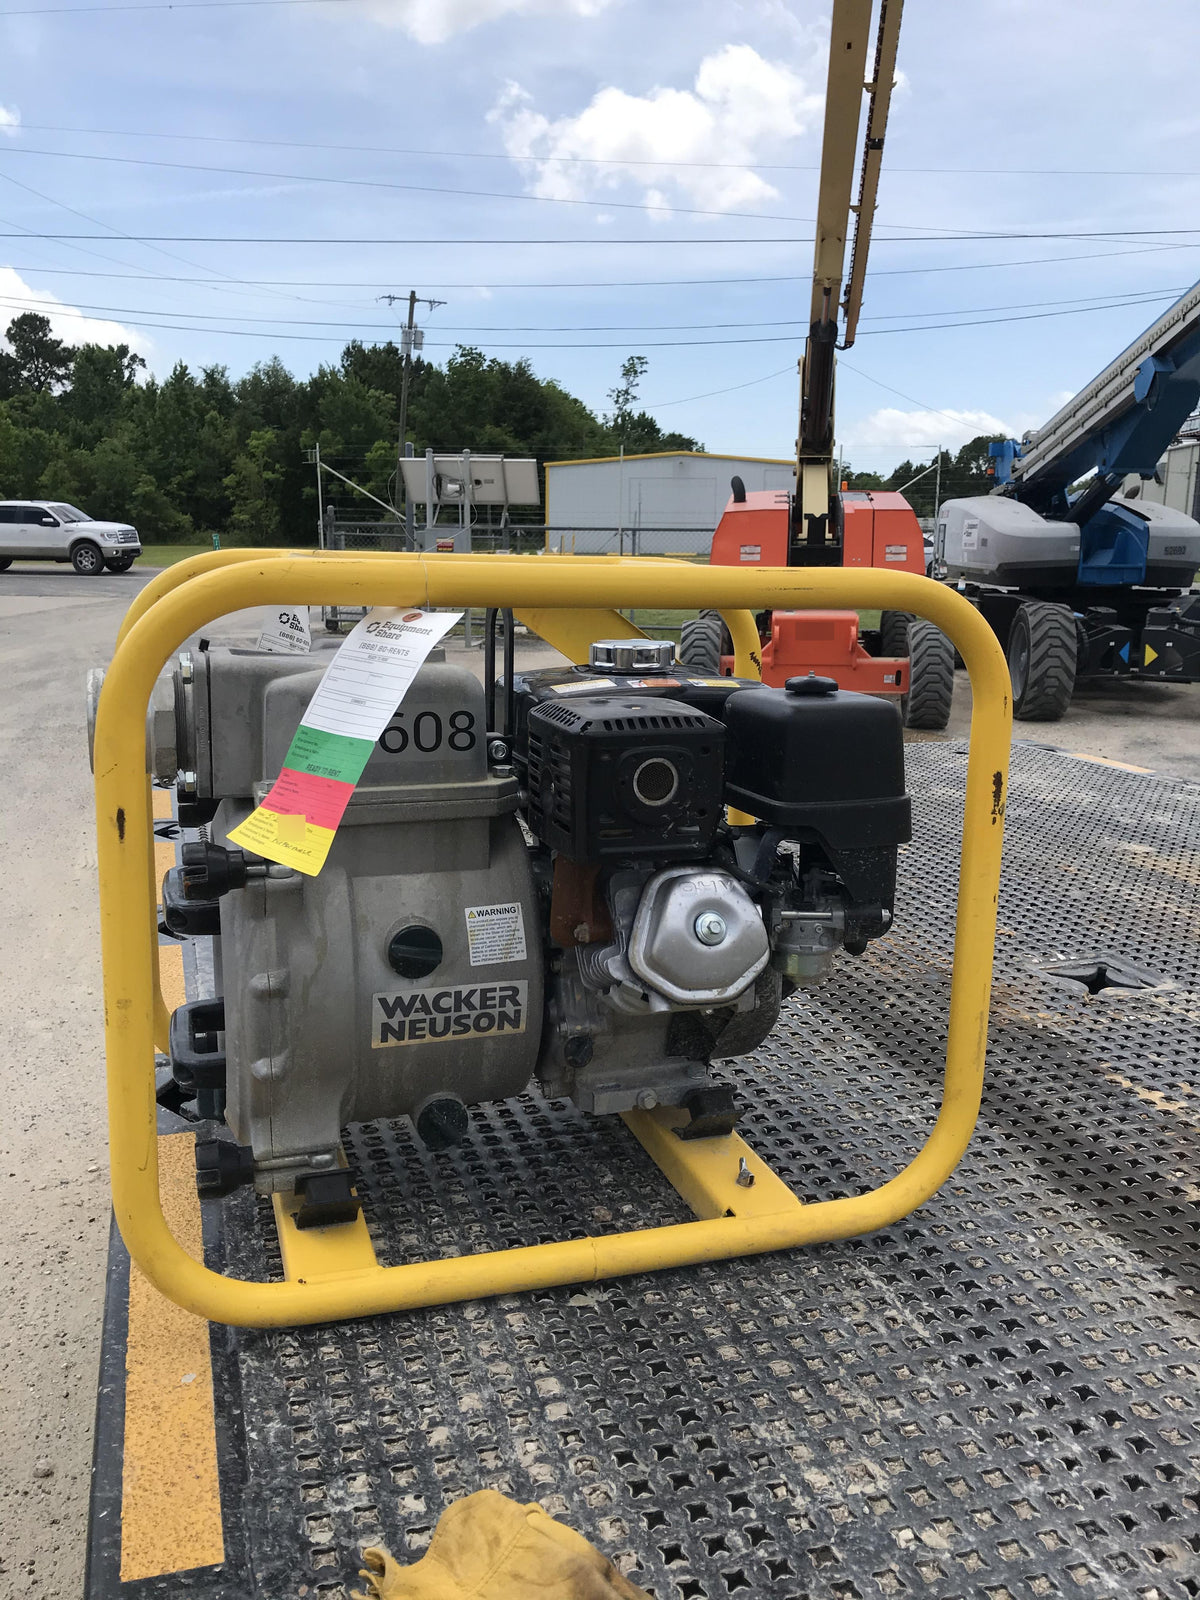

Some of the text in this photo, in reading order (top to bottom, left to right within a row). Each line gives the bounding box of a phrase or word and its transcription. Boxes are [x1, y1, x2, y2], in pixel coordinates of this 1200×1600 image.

[374, 629, 402, 640] Share
[382, 621, 433, 636] Equipment
[476, 906, 516, 918] WARNING
[378, 986, 522, 1020] WACKER
[380, 1008, 522, 1043] NEUSON
